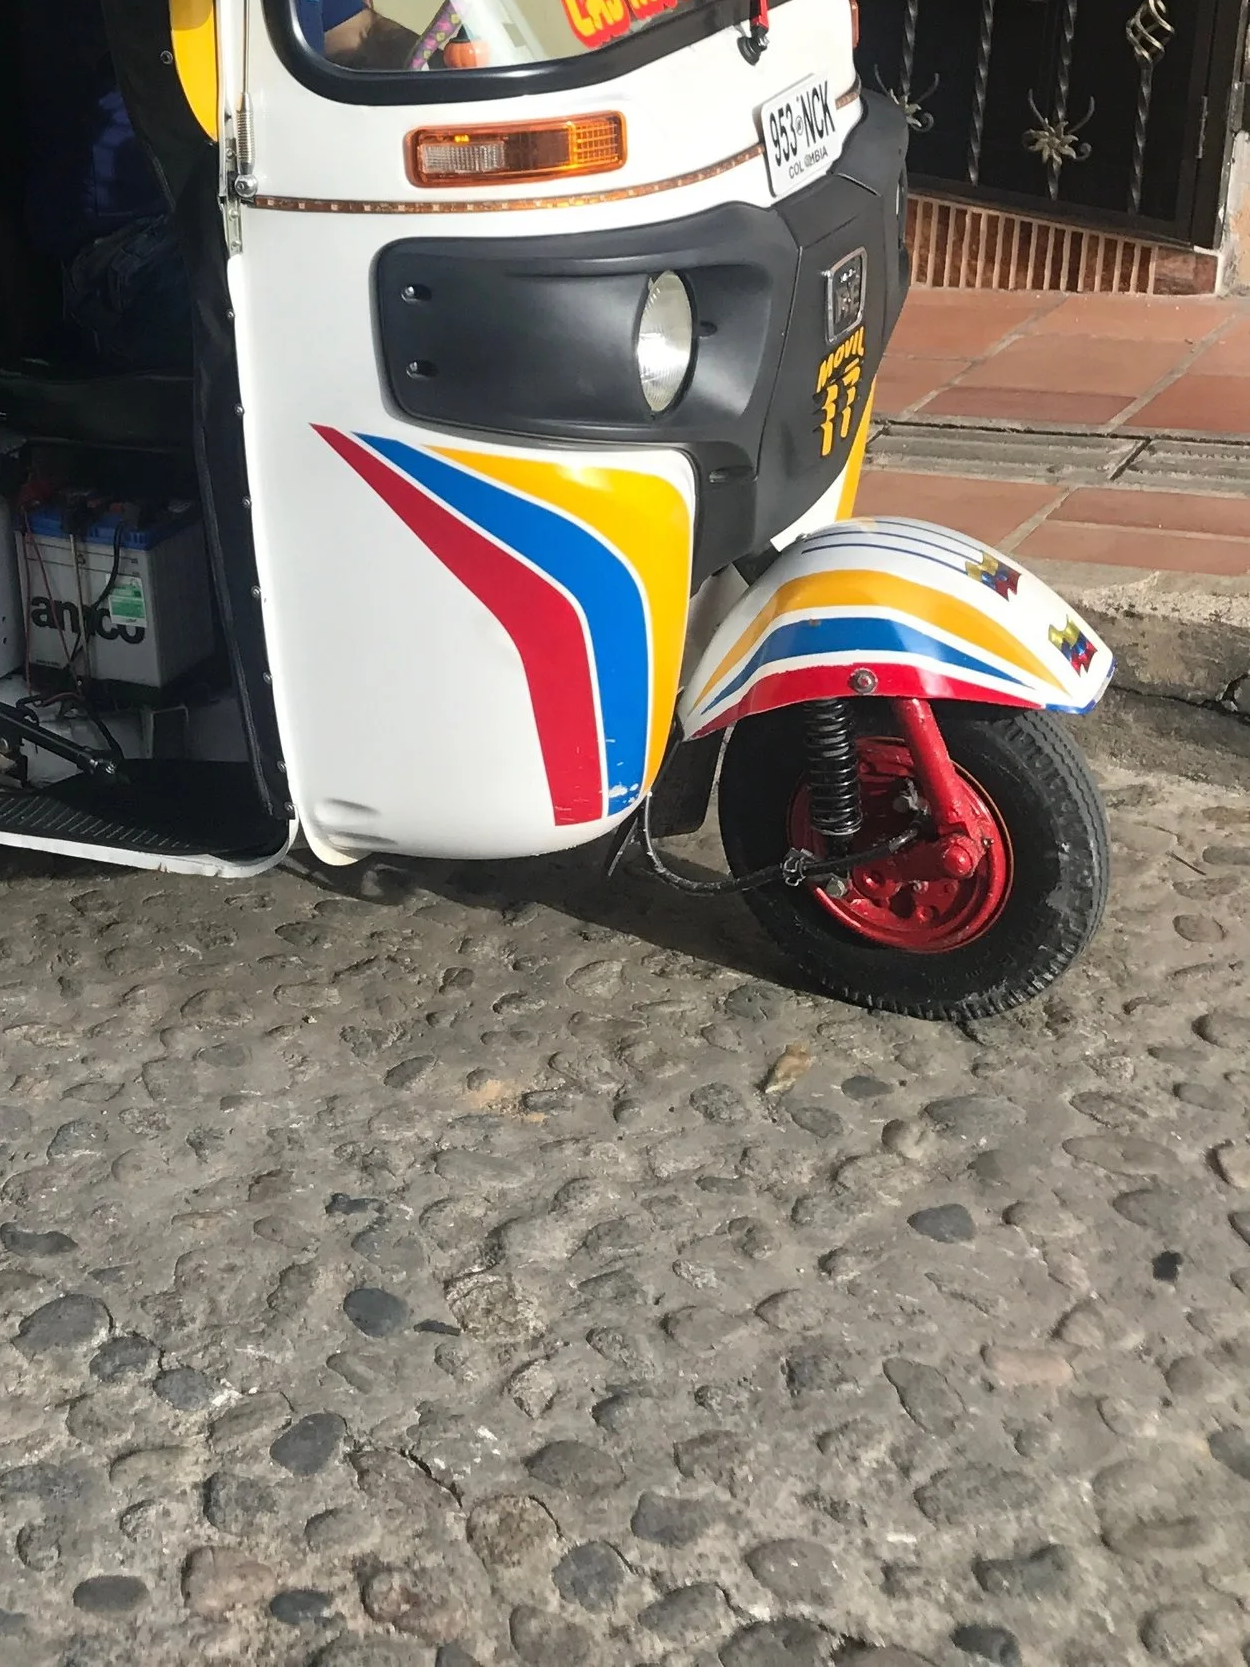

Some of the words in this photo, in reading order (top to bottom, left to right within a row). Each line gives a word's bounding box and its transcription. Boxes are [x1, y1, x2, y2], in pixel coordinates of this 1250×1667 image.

[769, 102, 798, 167] 953
[800, 80, 836, 148] NCK
[816, 325, 864, 393] MOVIL
